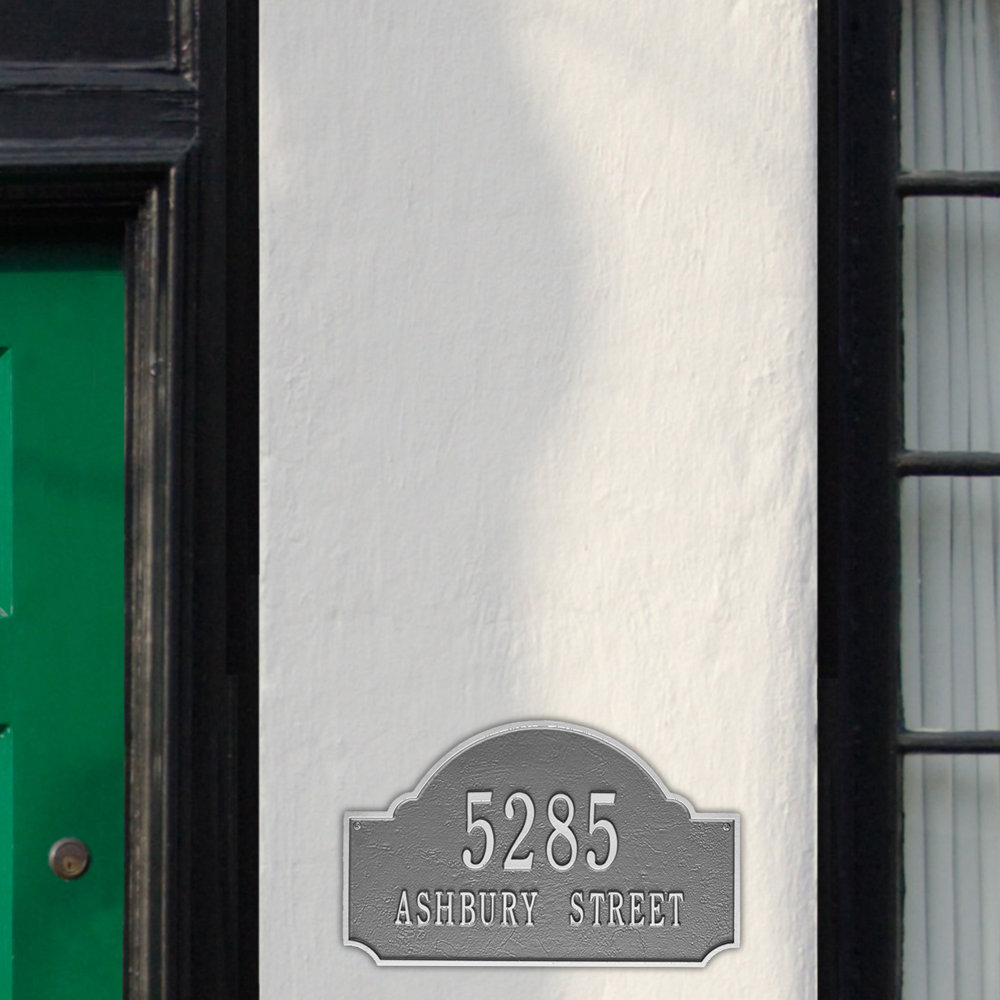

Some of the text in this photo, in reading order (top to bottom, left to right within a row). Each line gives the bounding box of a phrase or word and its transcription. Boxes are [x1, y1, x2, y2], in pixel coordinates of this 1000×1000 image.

[462, 791, 618, 871] 5285
[395, 889, 685, 927] ASHBURY STREET
